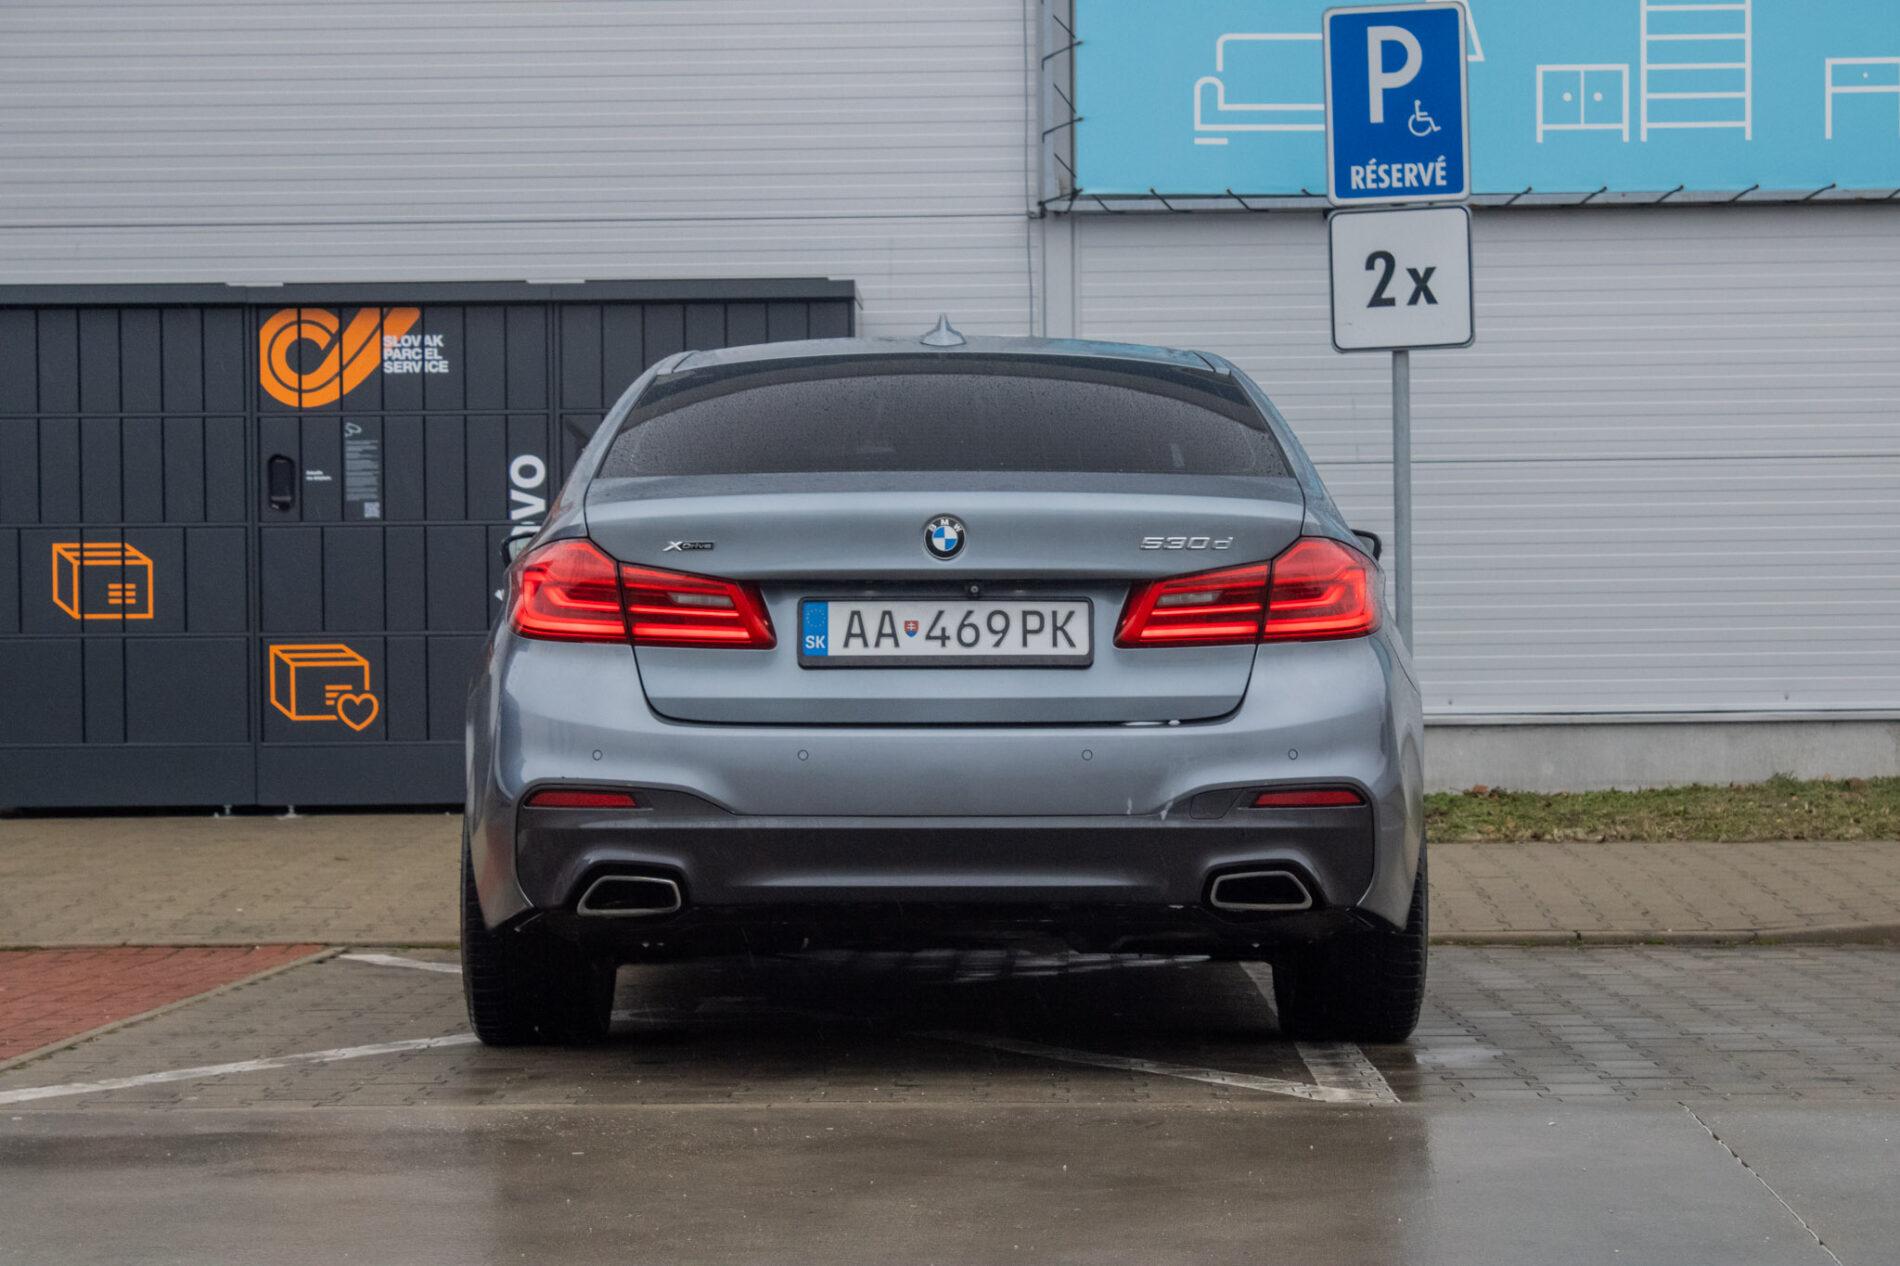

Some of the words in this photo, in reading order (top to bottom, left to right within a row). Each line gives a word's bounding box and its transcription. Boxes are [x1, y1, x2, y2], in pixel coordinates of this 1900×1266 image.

[1367, 25, 1423, 124] P
[1350, 155, 1448, 190] RÉSERVÉ
[1364, 250, 1439, 309] 2x
[383, 335, 444, 348] SLOVAK
[383, 348, 443, 360] PARCEL
[383, 360, 449, 373] SERVICE
[1140, 536, 1234, 550] 530d
[805, 635, 826, 649] SK
